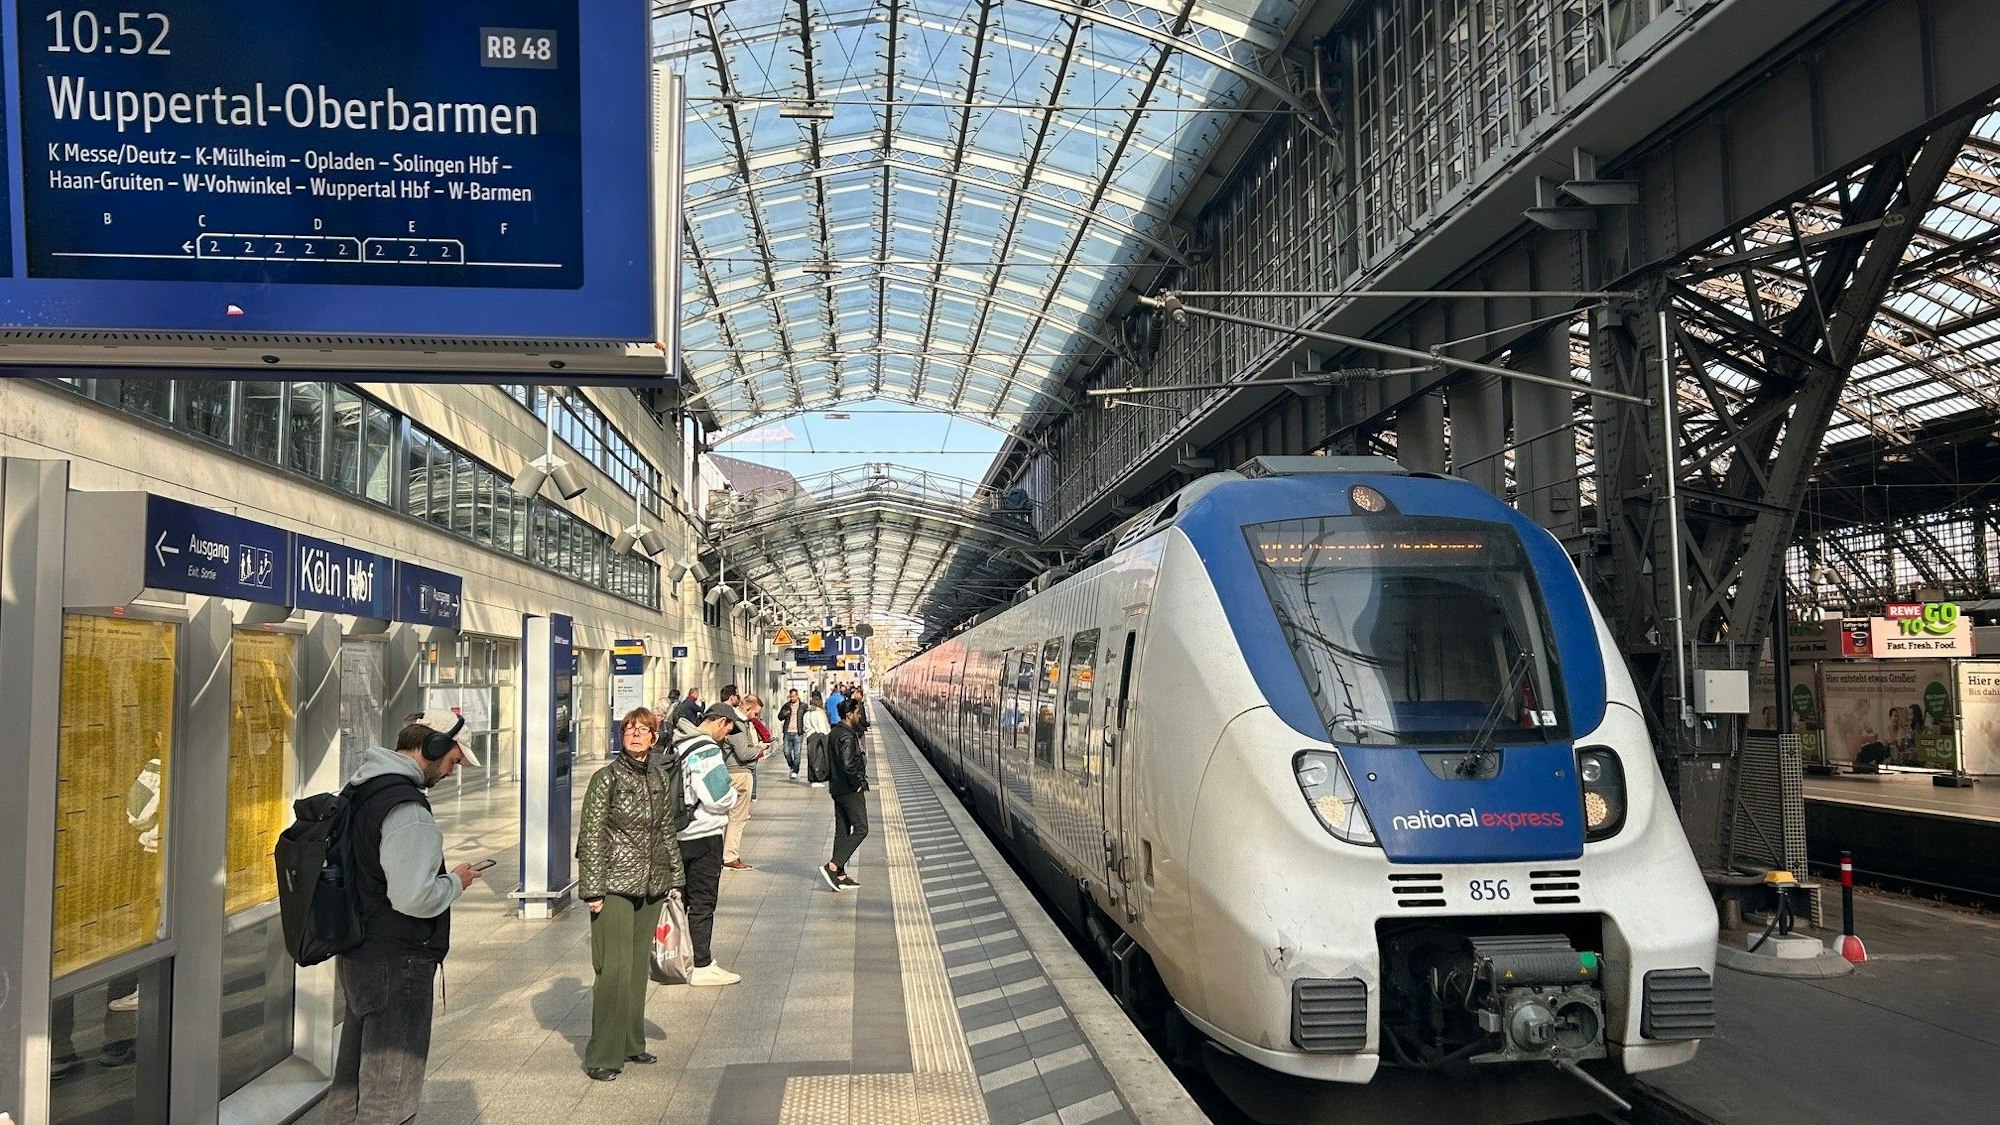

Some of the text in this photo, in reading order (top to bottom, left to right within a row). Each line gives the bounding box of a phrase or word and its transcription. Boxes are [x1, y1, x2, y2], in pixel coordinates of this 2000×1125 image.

[46, 10, 171, 56] 10:52
[487, 35, 551, 60] RB 48
[46, 75, 537, 135] Wuppertal-Oberbarmen
[48, 142, 60, 162] K
[64, 143, 177, 166] Messe/Deutz
[195, 146, 286, 168] K-Mülheim
[304, 150, 375, 174] Opladen
[392, 153, 465, 178] Solingen
[469, 155, 499, 175] Hbf
[49, 169, 164, 192] Haan-Gruiten
[182, 172, 292, 196] W-Vohwinkel
[309, 177, 397, 201] Wuppertal
[400, 179, 431, 199] Hbf
[448, 181, 532, 202] W-Barmen
[103, 212, 508, 235] B C D E F
[188, 533, 230, 564] Ausgang
[301, 546, 374, 603] Köln Hbf
[1890, 603, 1957, 623] REWE GO
[1900, 619, 1924, 634] TO
[850, 636, 863, 652] D
[1887, 641, 1956, 650] Fast. Fresh. Food.
[1968, 675, 1992, 686] Hier
[1968, 687, 1981, 696] Bis
[1936, 739, 1952, 752] GO
[1392, 807, 1565, 832] national express
[1469, 879, 1511, 901] 856
